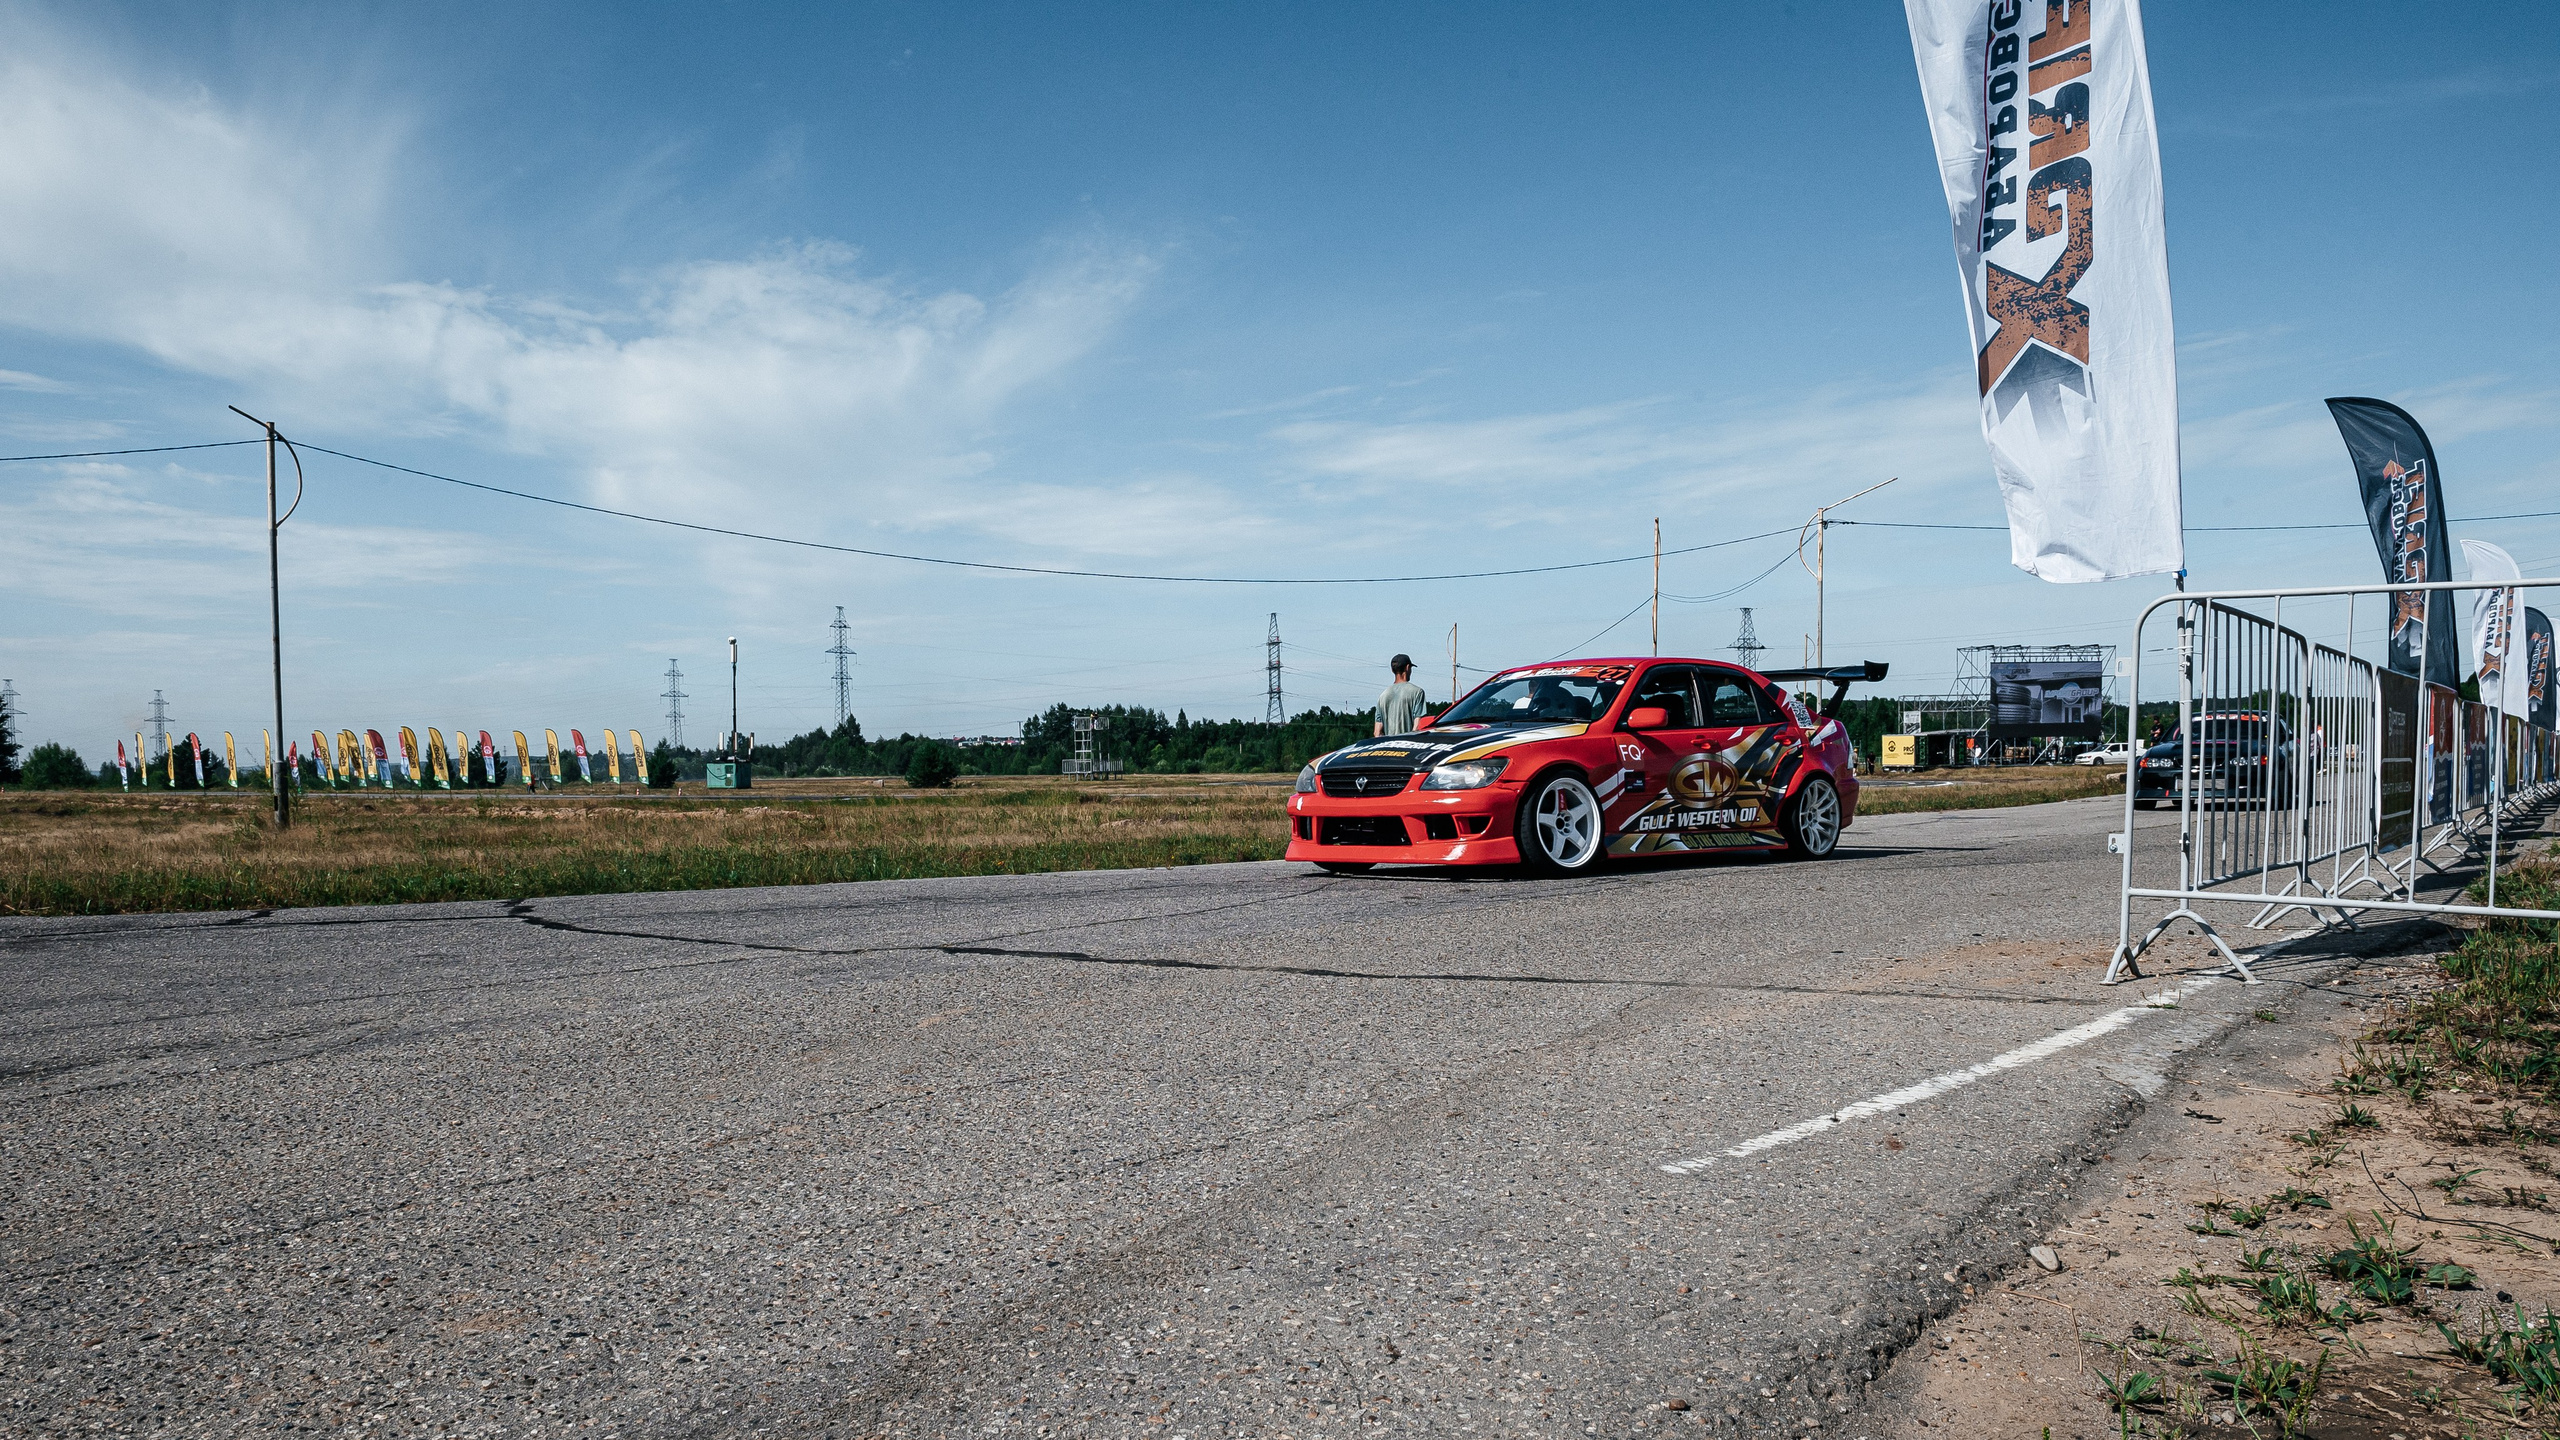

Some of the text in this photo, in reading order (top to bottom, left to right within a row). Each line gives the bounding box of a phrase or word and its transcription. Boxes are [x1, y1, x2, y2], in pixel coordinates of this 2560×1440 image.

[1600, 668, 1629, 679] 27
[2070, 687, 2099, 697] GROUP
[1675, 760, 1732, 798] GW
[1639, 813, 1675, 831] GULF
[1677, 808, 1738, 828] WESTERN
[1681, 832, 1757, 849] GO THE DISTANCE
